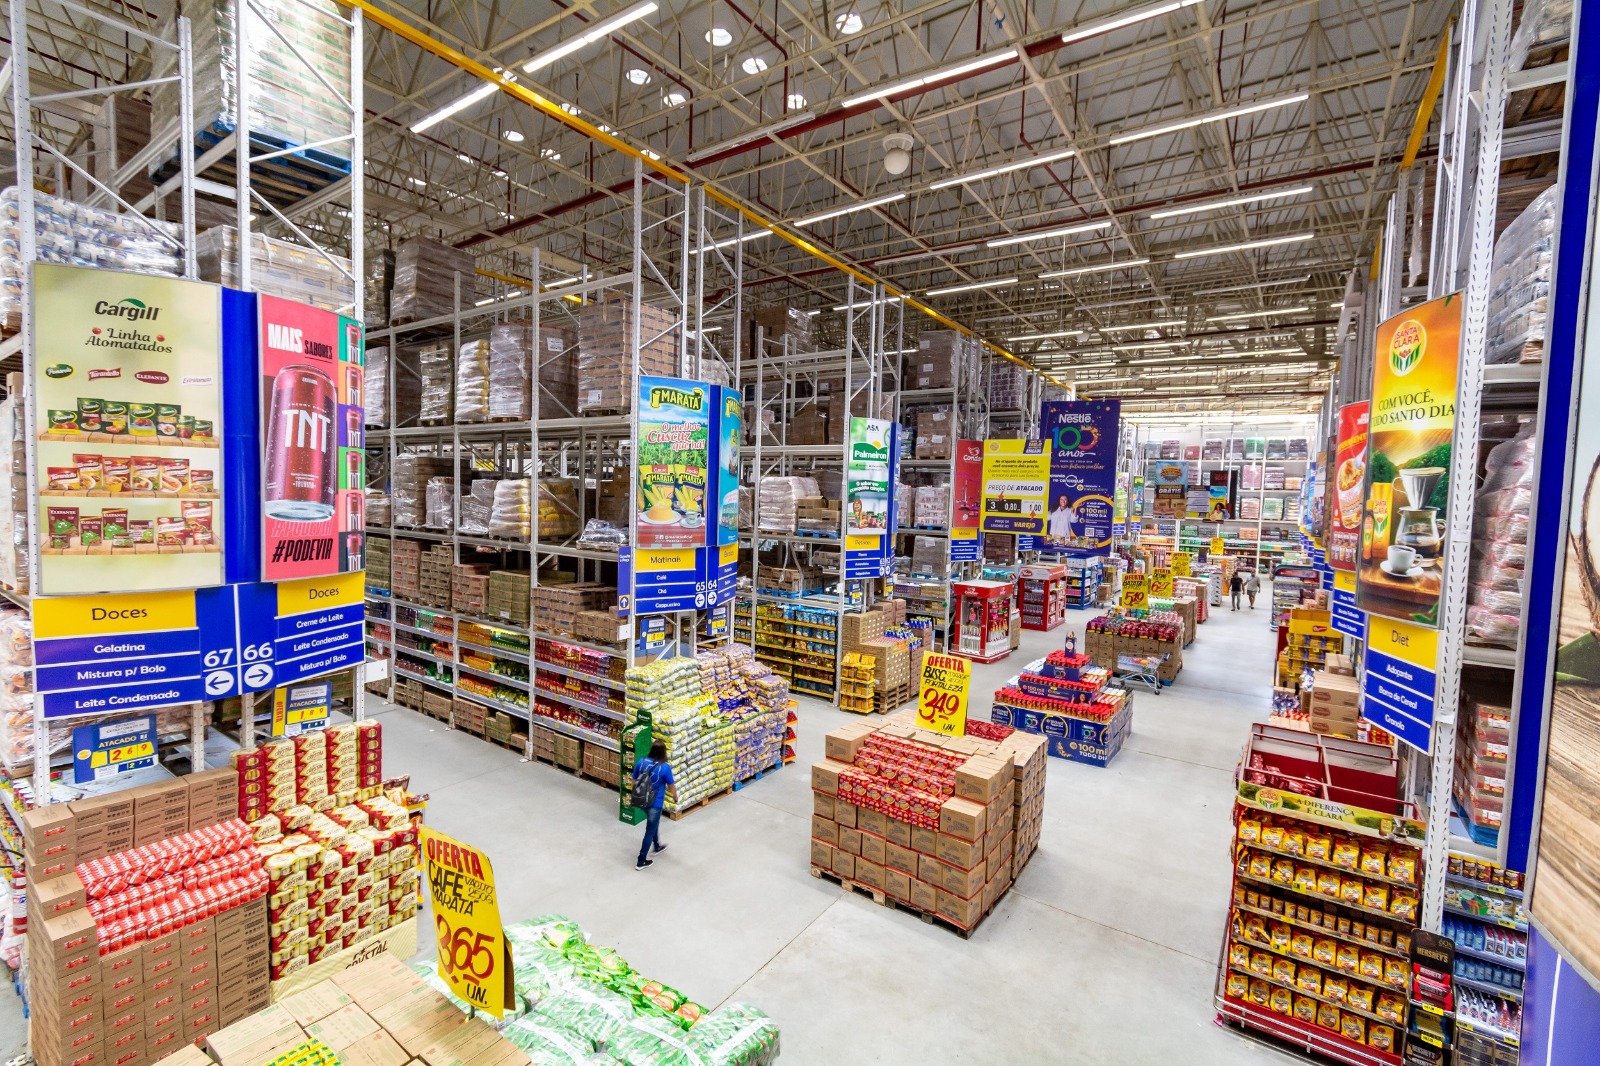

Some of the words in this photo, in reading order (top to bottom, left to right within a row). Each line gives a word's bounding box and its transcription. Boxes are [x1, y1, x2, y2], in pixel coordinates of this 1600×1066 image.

[95, 300, 160, 321] Cargill
[107, 327, 150, 342] Linha
[267, 322, 303, 354] MAIS
[1396, 326, 1418, 339] SANTA
[85, 335, 173, 354] Atomatados
[1394, 334, 1420, 349] CLARA
[304, 340, 333, 360] SABORES
[136, 373, 168, 381] ELEFANTE
[662, 390, 701, 409] MARATÁ
[1378, 396, 1397, 411] COM
[1389, 407, 1425, 423] SANTO
[1429, 404, 1455, 418] DIA
[281, 409, 331, 454] TNT
[672, 423, 701, 432] melhor
[647, 431, 691, 443] Cuscuz
[1051, 426, 1099, 451] 100
[854, 450, 887, 460] Palmeiron
[1058, 450, 1096, 458] anos
[990, 501, 996, 510] 3
[1004, 502, 1018, 511] 0,80
[1029, 504, 1042, 512] 1,00
[1013, 521, 1036, 529] VAREJO
[271, 538, 334, 563] #PODEVIR
[650, 556, 682, 564] Matinais
[695, 582, 705, 592] 65
[707, 580, 717, 590] 64
[309, 587, 340, 600] Doces
[91, 606, 148, 621] Doces
[295, 618, 318, 629] Creme
[318, 615, 327, 624] de
[327, 612, 344, 622] Leite
[293, 643, 309, 652] Leite
[310, 632, 349, 648] Condensado
[1391, 630, 1409, 647] Diet
[94, 642, 146, 654] Gelatina
[243, 642, 273, 660] 66
[203, 648, 234, 667] 67
[299, 662, 324, 673] Mistura
[324, 659, 332, 669] p/
[332, 653, 347, 664] Bolo
[927, 655, 965, 674] OFERTA
[77, 668, 122, 682] Mistura
[124, 666, 138, 680] p/
[140, 663, 166, 675] Bolo
[75, 696, 105, 710] Leite
[107, 688, 180, 707] Condensado
[289, 699, 317, 708] ATACADO
[98, 735, 137, 749] ATACADO
[1078, 743, 1094, 753] 100
[1079, 750, 1096, 759] TODO
[1304, 800, 1356, 818] DIFERENÇA
[1313, 809, 1344, 822] CLARA
[427, 837, 485, 881] OFERTA
[1416, 947, 1449, 964] HERSHEY'S
